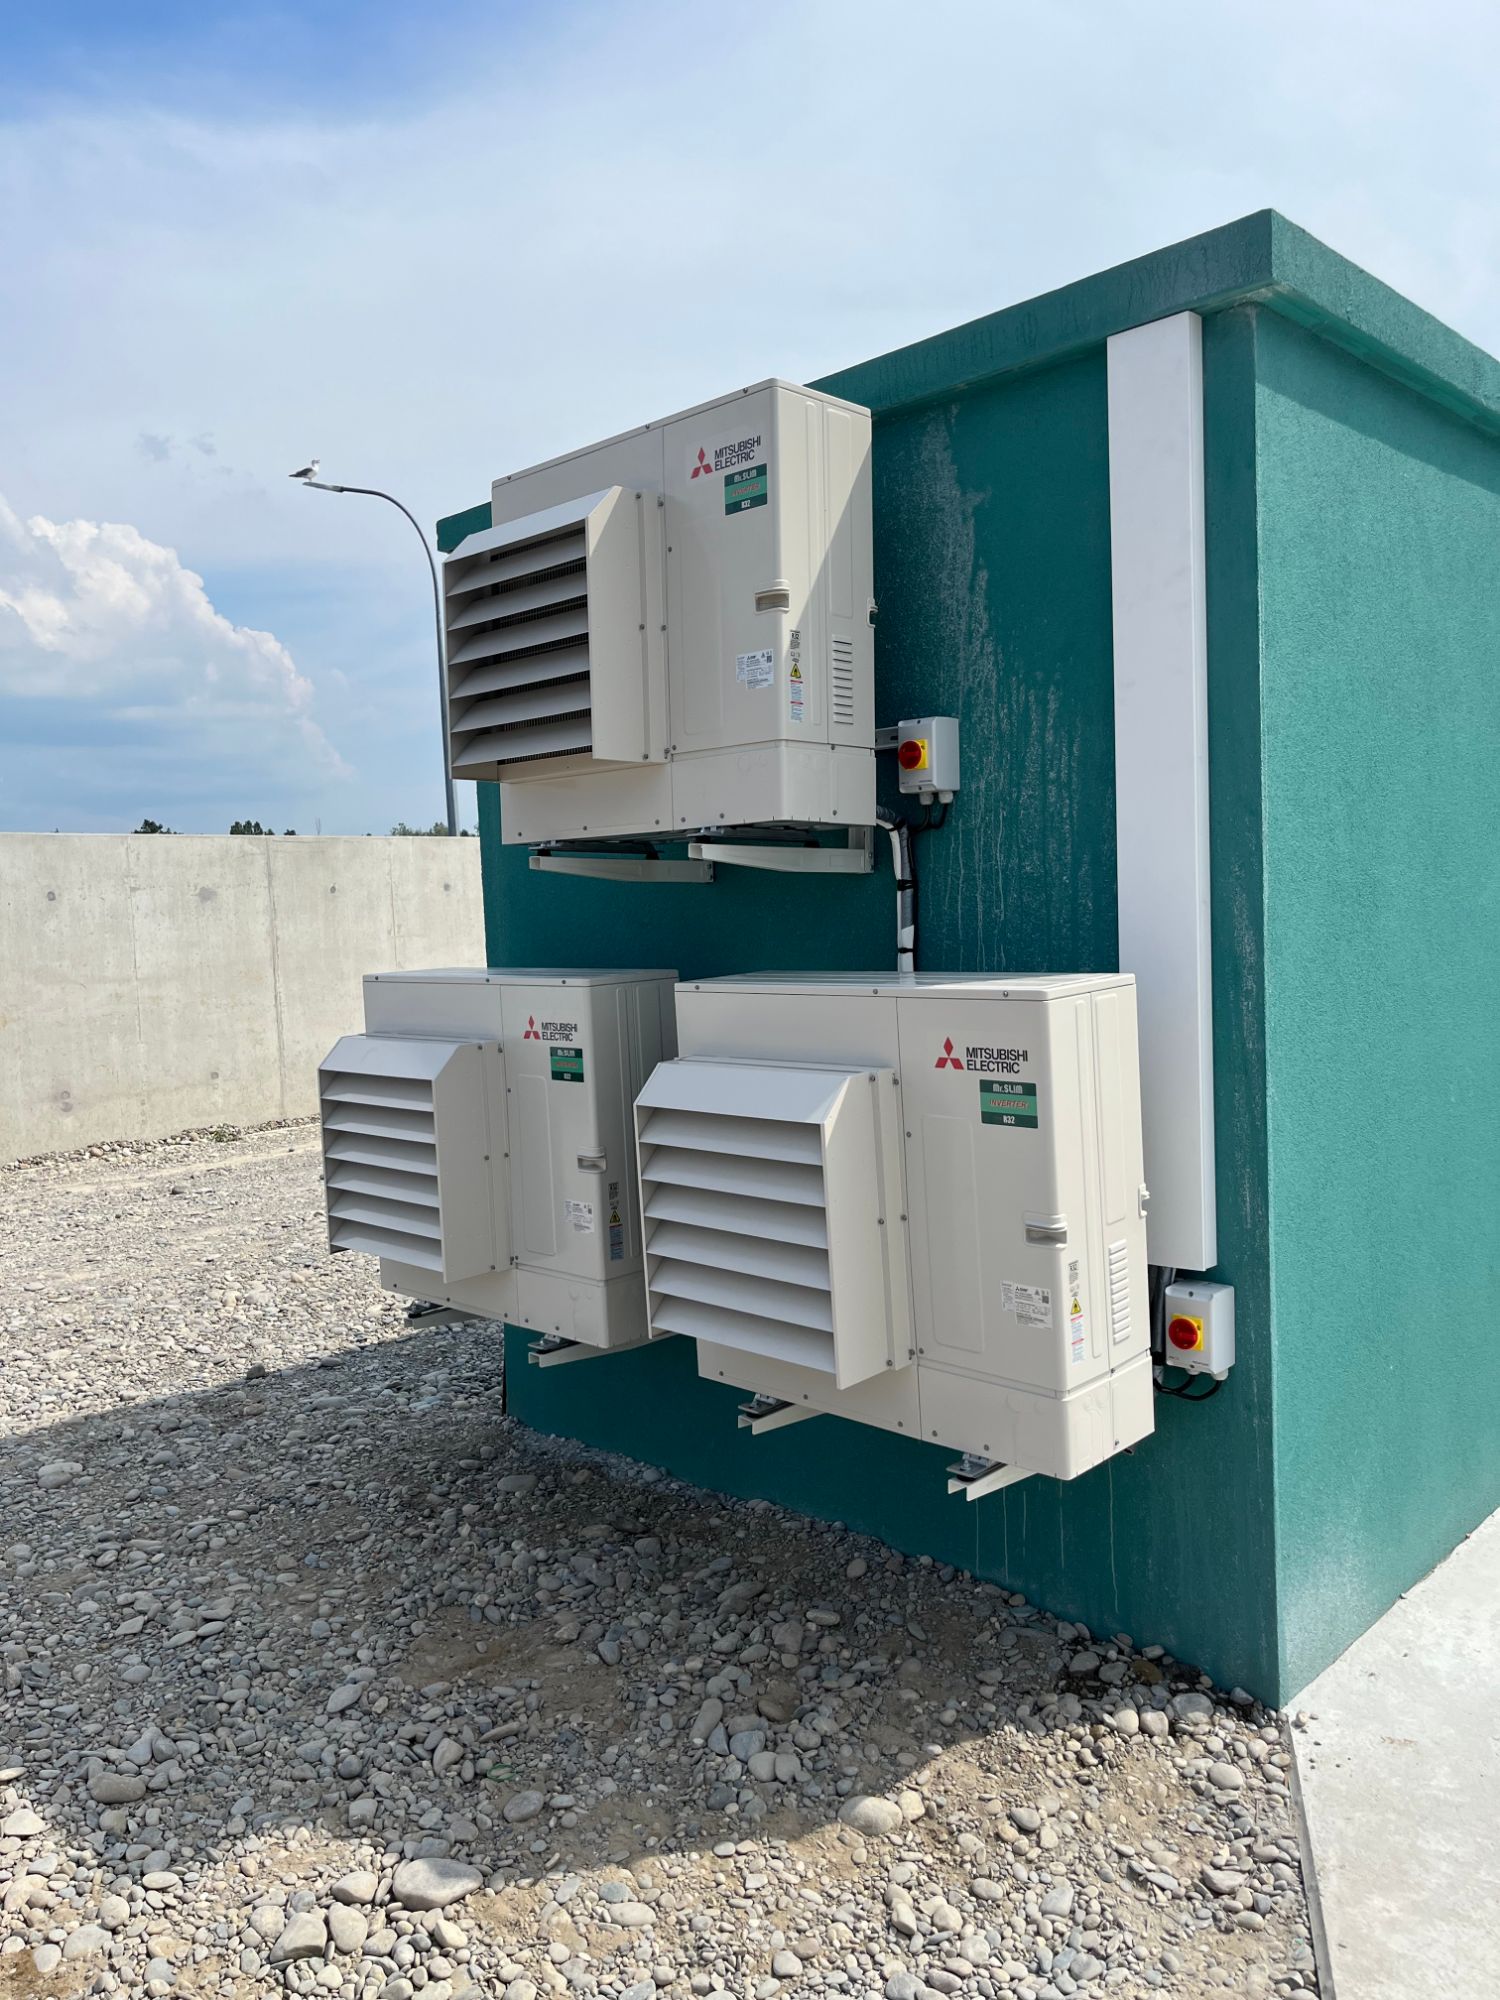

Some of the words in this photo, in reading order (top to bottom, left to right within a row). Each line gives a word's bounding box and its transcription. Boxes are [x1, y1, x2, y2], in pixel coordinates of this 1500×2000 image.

[714, 434, 761, 460] MITSUBISHI
[714, 449, 755, 471] ELECTRIC
[541, 1022, 578, 1033] MITSUBISHI
[542, 1032, 573, 1042] ELECTRIC
[966, 1046, 1029, 1062] MITSUBISHI
[966, 1059, 1020, 1074] ELECTRIC
